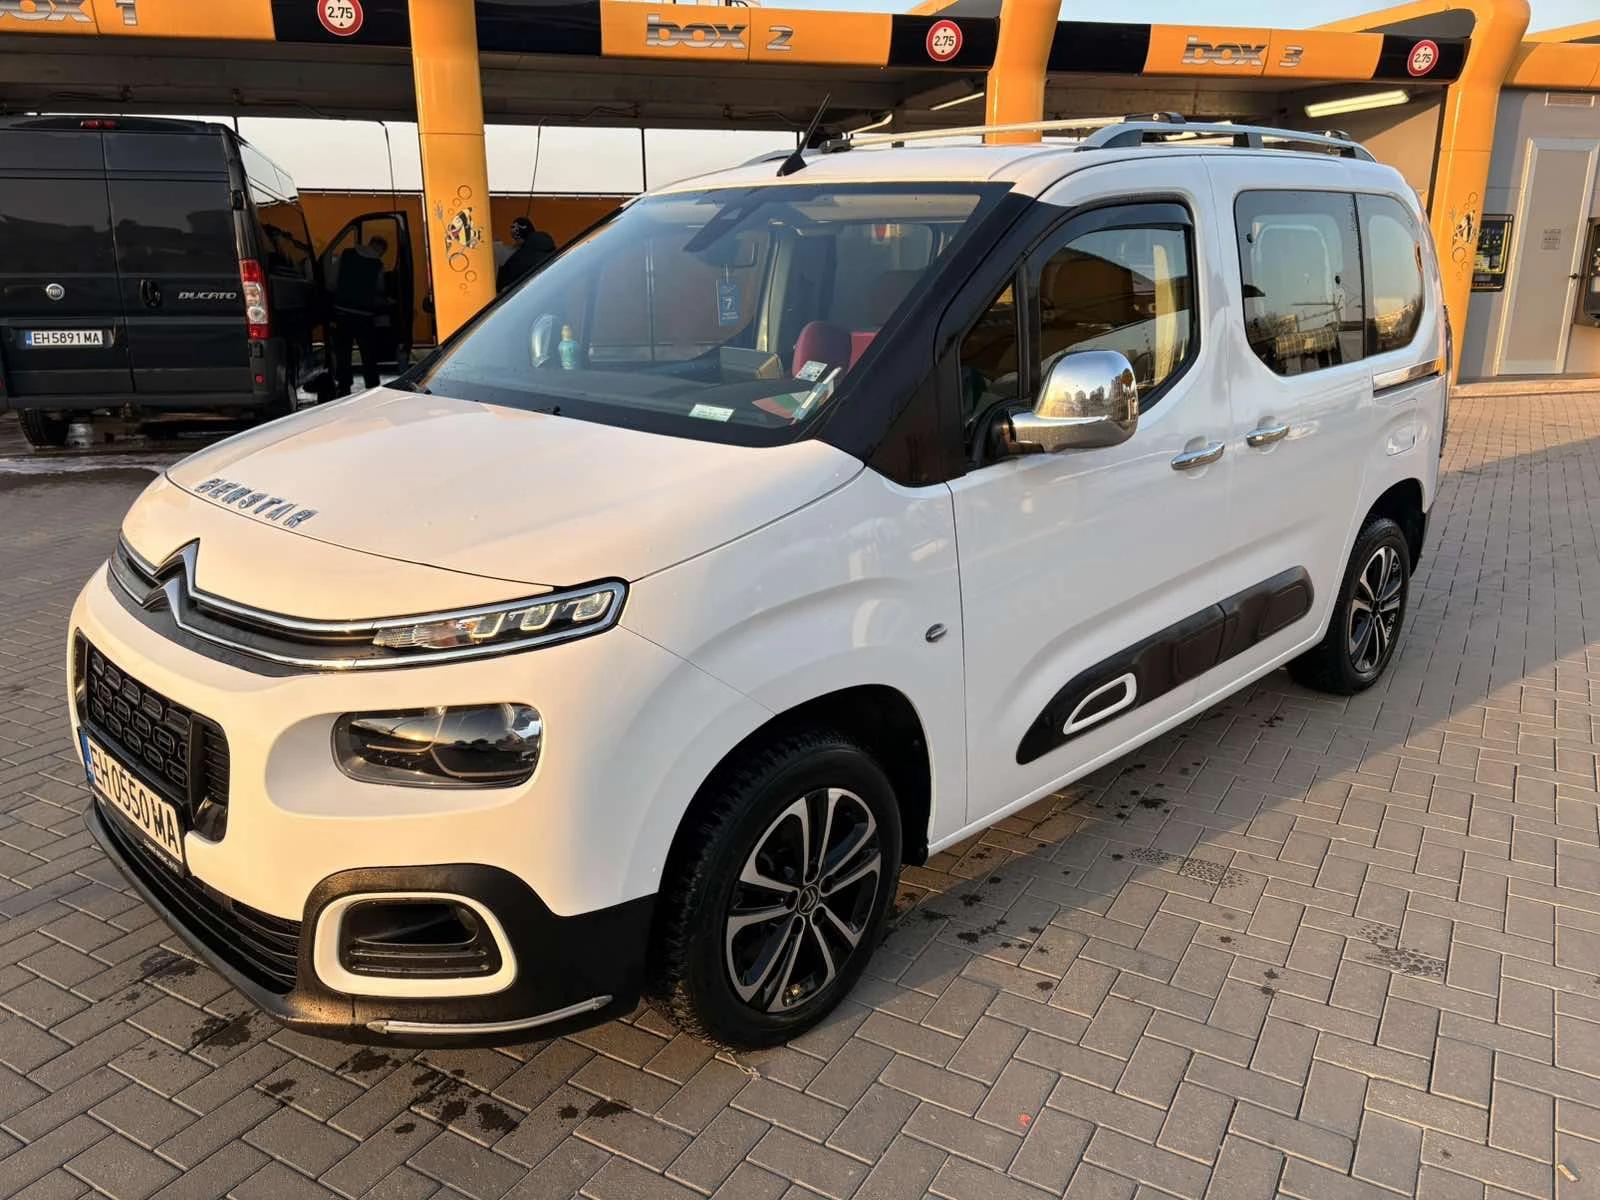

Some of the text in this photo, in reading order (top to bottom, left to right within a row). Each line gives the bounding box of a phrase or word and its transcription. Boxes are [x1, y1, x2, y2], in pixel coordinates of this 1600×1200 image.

[0, 0, 93, 22] ox
[327, 6, 353, 19] 2.75
[646, 13, 794, 50] box 2
[934, 35, 955, 47] 2.75
[1182, 35, 1304, 67] box 3
[1414, 52, 1432, 64] 2.75
[178, 291, 237, 299] DUCATO
